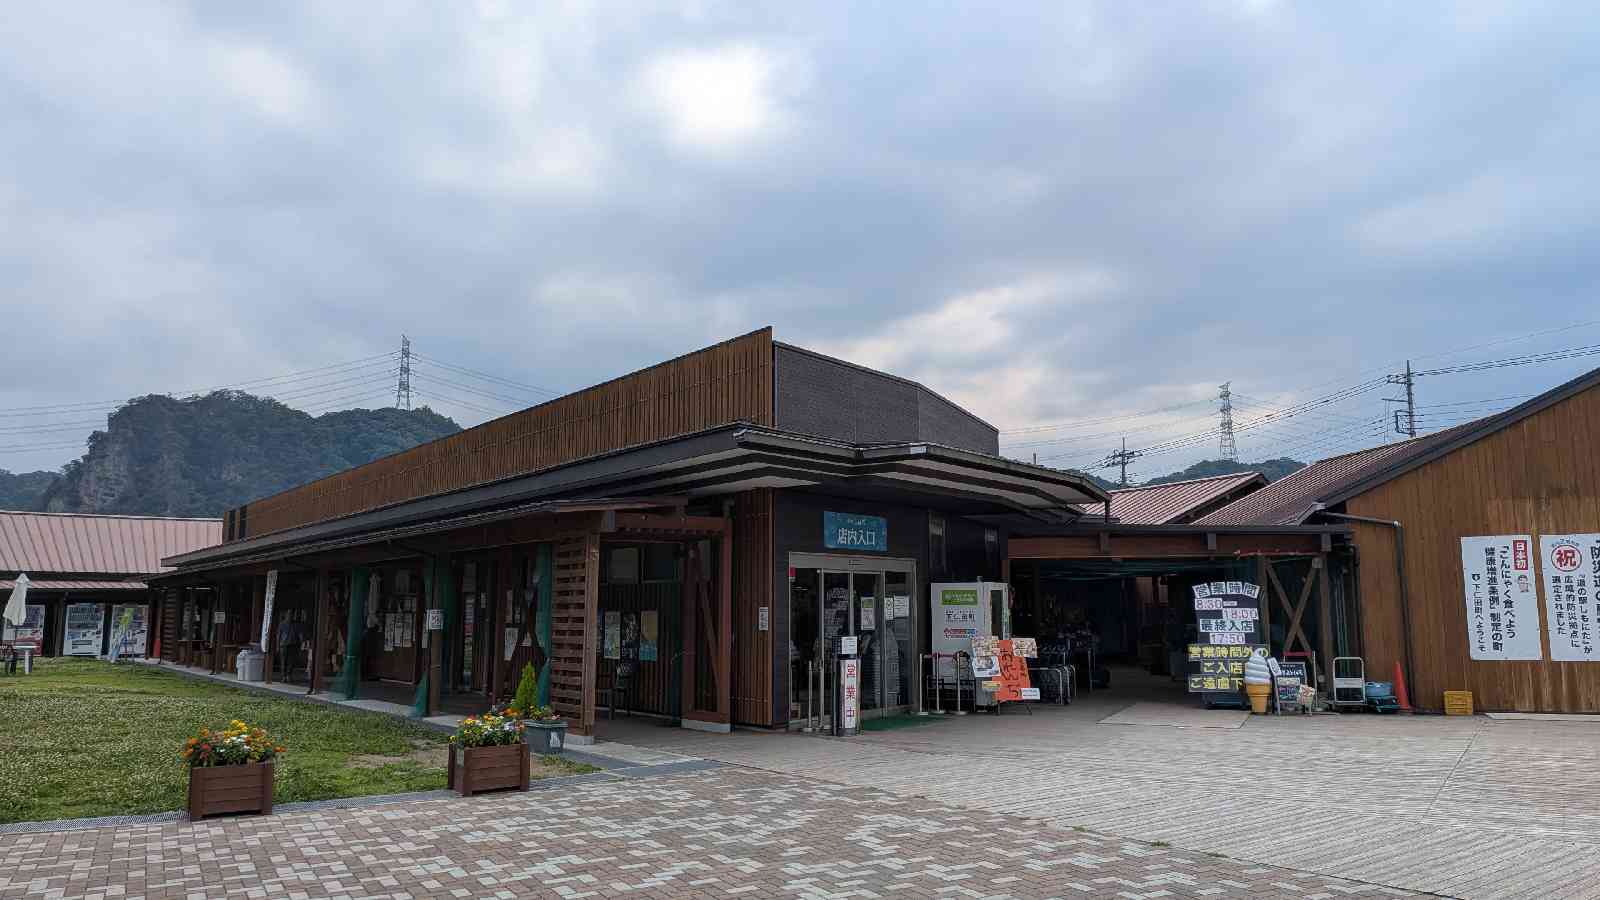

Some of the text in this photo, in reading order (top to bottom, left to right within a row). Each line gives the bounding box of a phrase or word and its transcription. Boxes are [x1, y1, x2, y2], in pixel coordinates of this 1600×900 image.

[837, 527, 876, 545] 店内入口
[1516, 542, 1527, 568] 日本初
[1555, 549, 1577, 568] 祝
[1194, 582, 1259, 598] 営業時間
[1201, 620, 1253, 632] 最終入店
[1203, 661, 1247, 674] ご入店
[846, 663, 856, 721] 営業中
[1190, 677, 1244, 690] ご遠慮下
